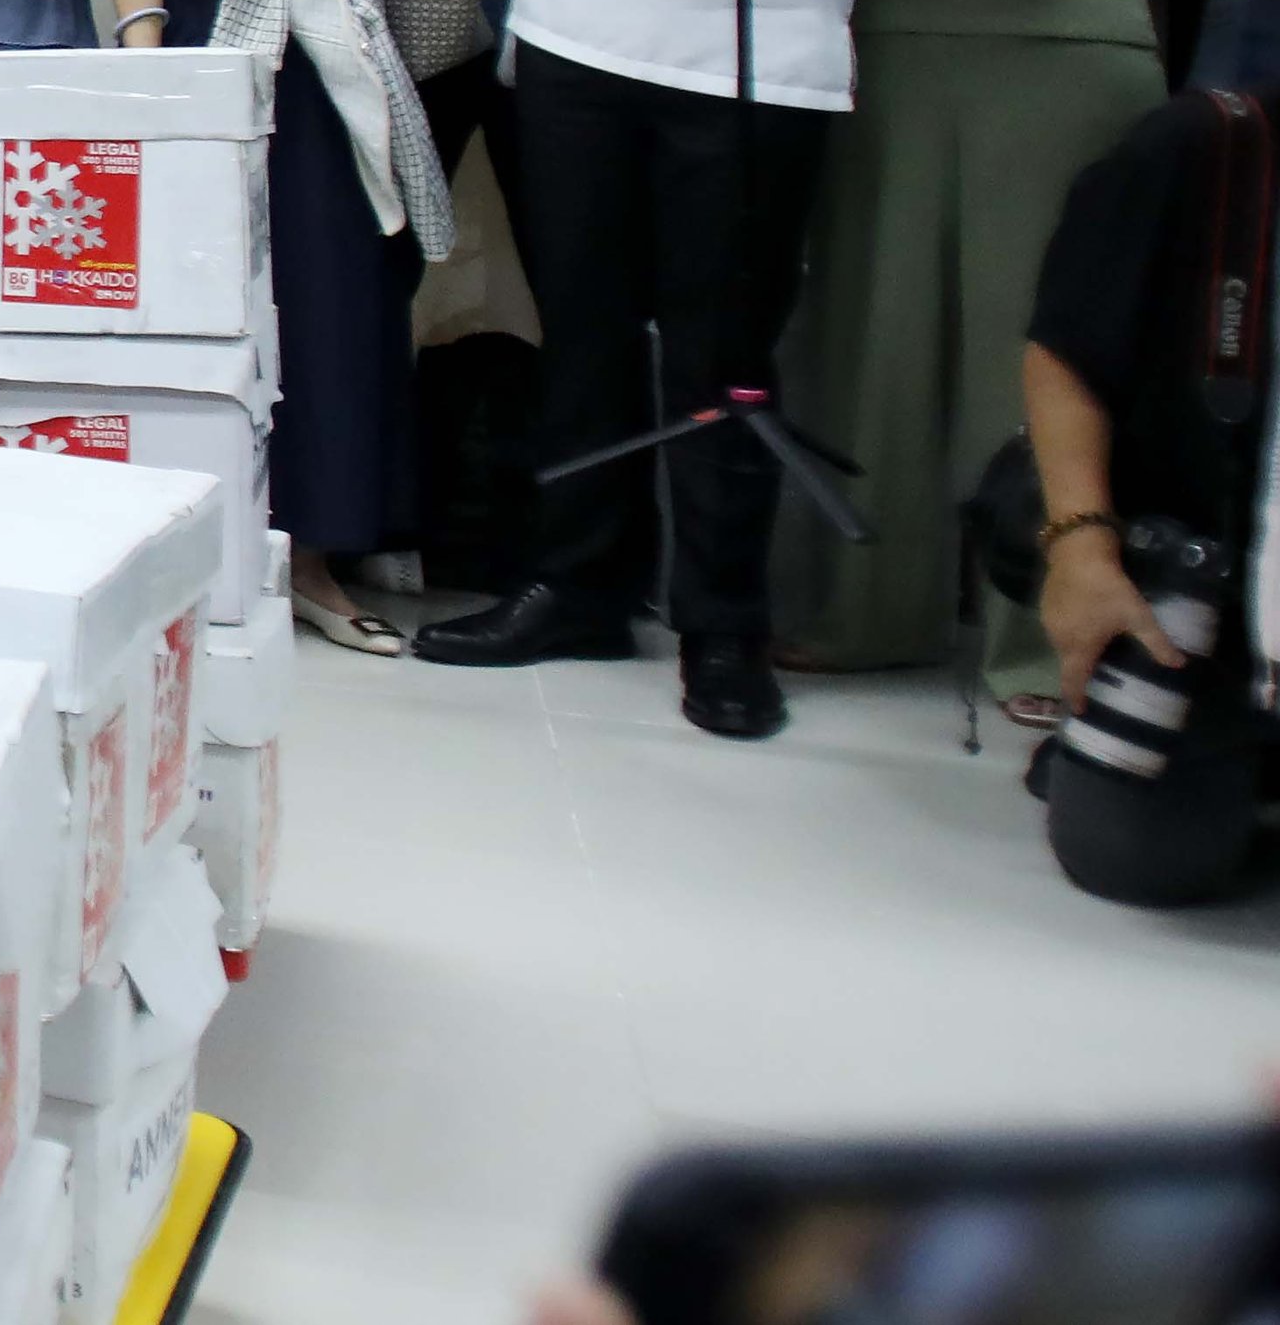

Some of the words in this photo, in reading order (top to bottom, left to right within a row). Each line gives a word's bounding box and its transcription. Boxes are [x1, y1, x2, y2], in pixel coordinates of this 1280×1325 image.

[88, 142, 139, 156] LEGAL
[102, 156, 140, 166] SHEETS
[75, 417, 127, 431] LEGAL
